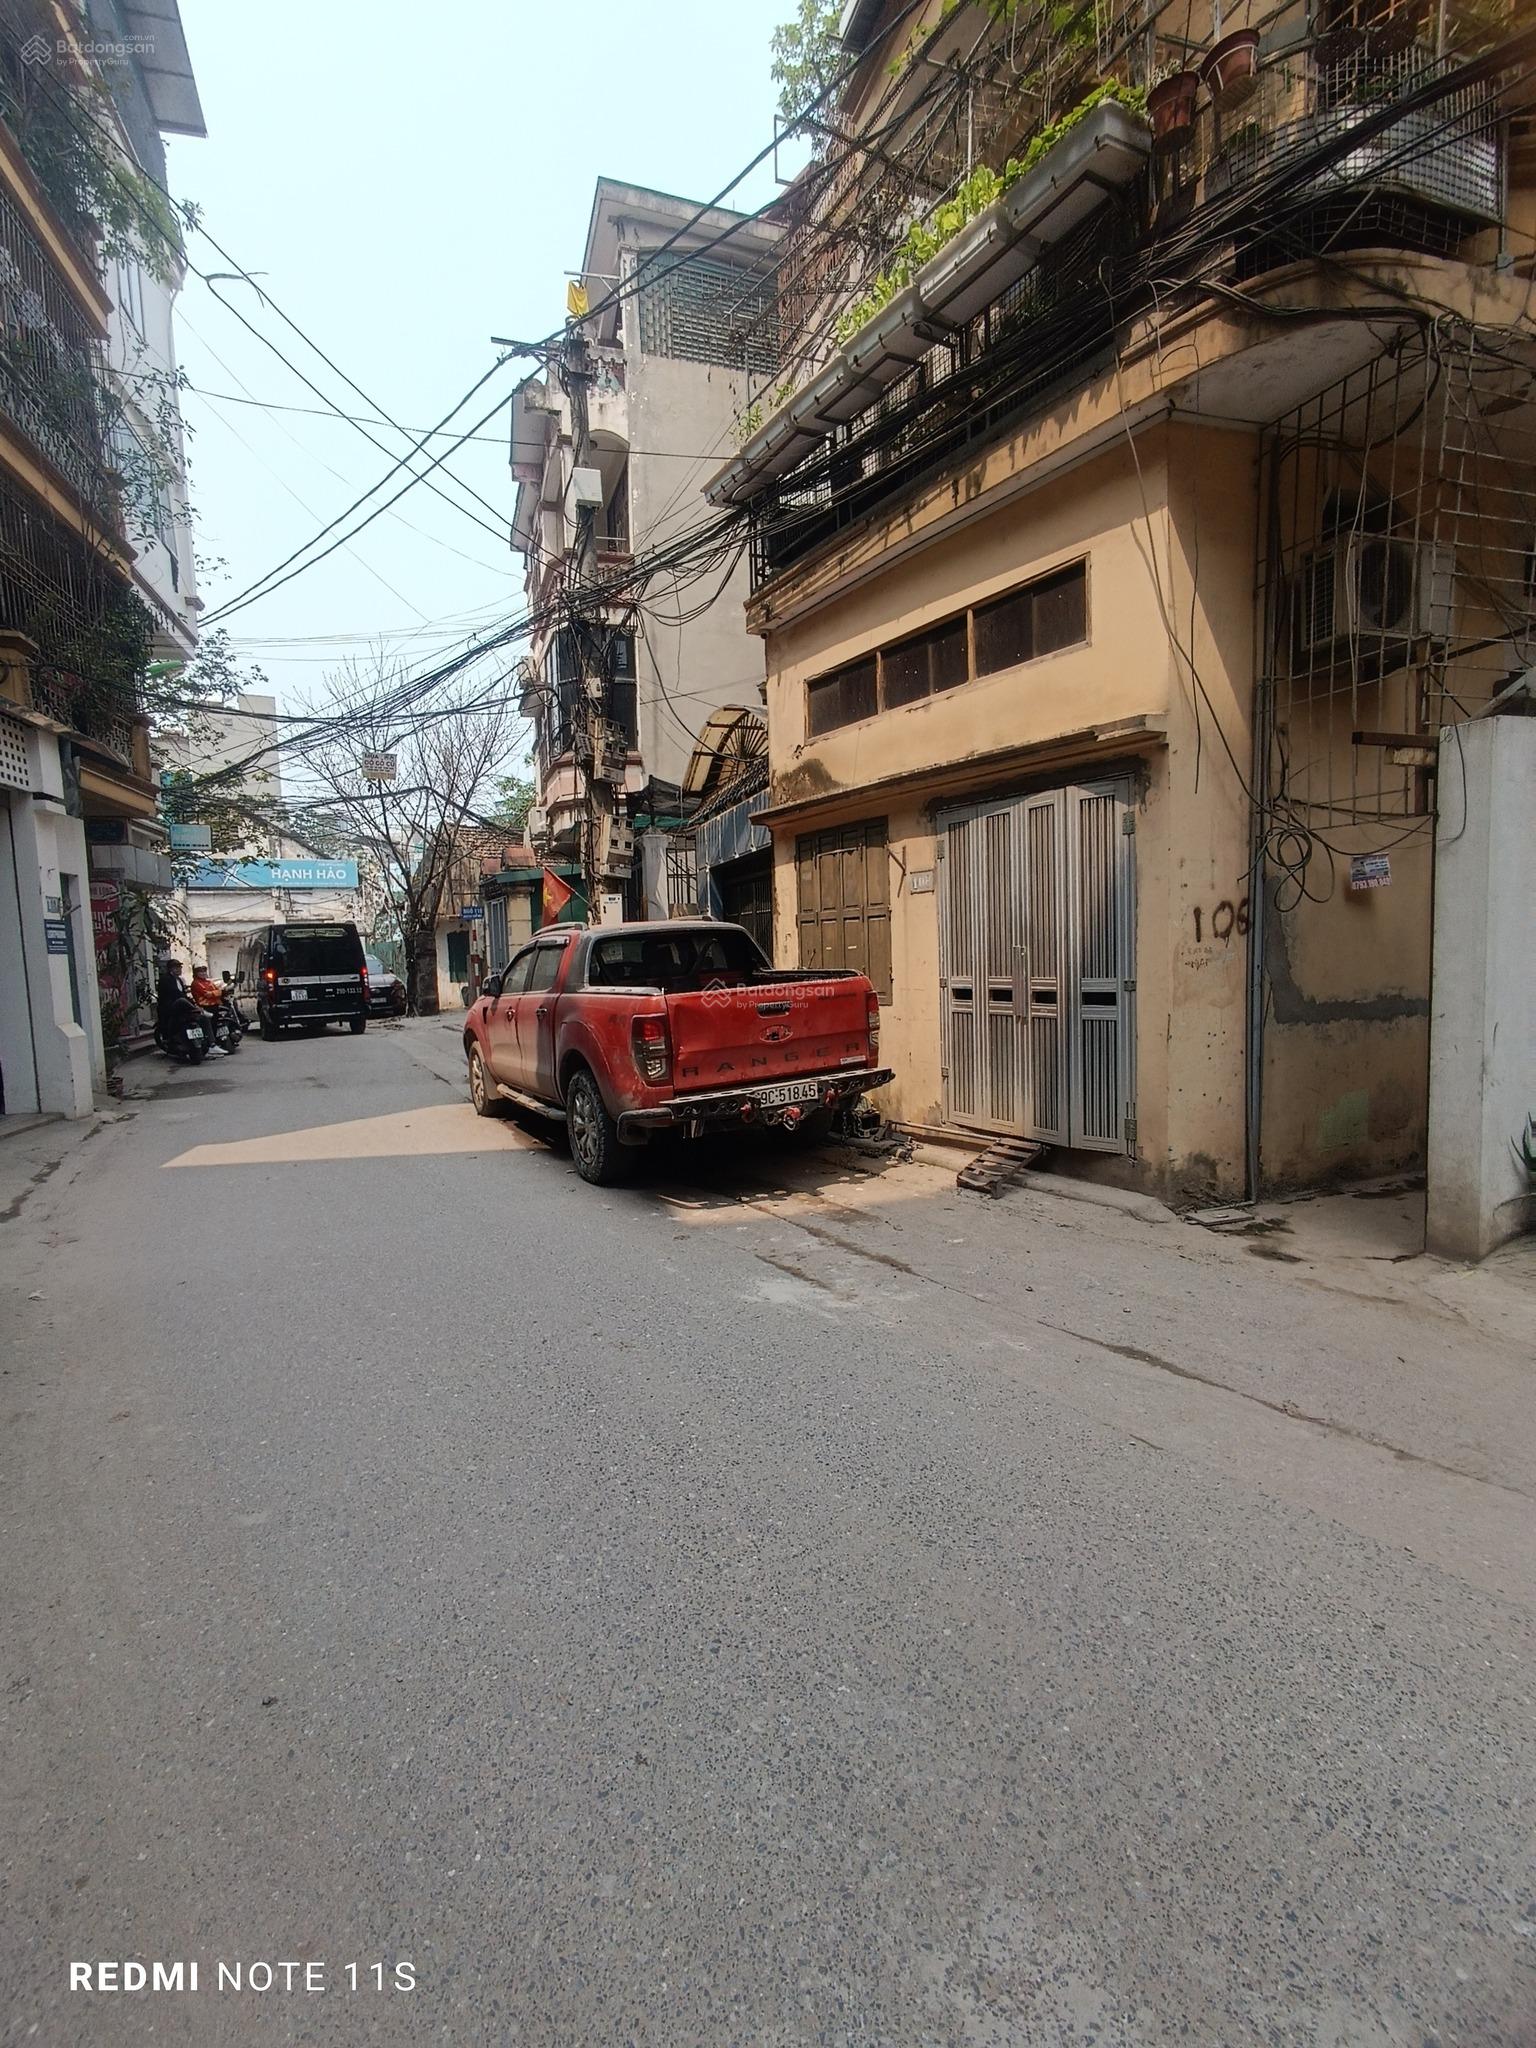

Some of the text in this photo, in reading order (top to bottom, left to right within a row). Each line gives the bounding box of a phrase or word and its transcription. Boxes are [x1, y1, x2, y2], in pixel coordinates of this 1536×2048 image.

[271, 866, 346, 881] HẠNH HẢO
[681, 1043, 859, 1078] RANGER
